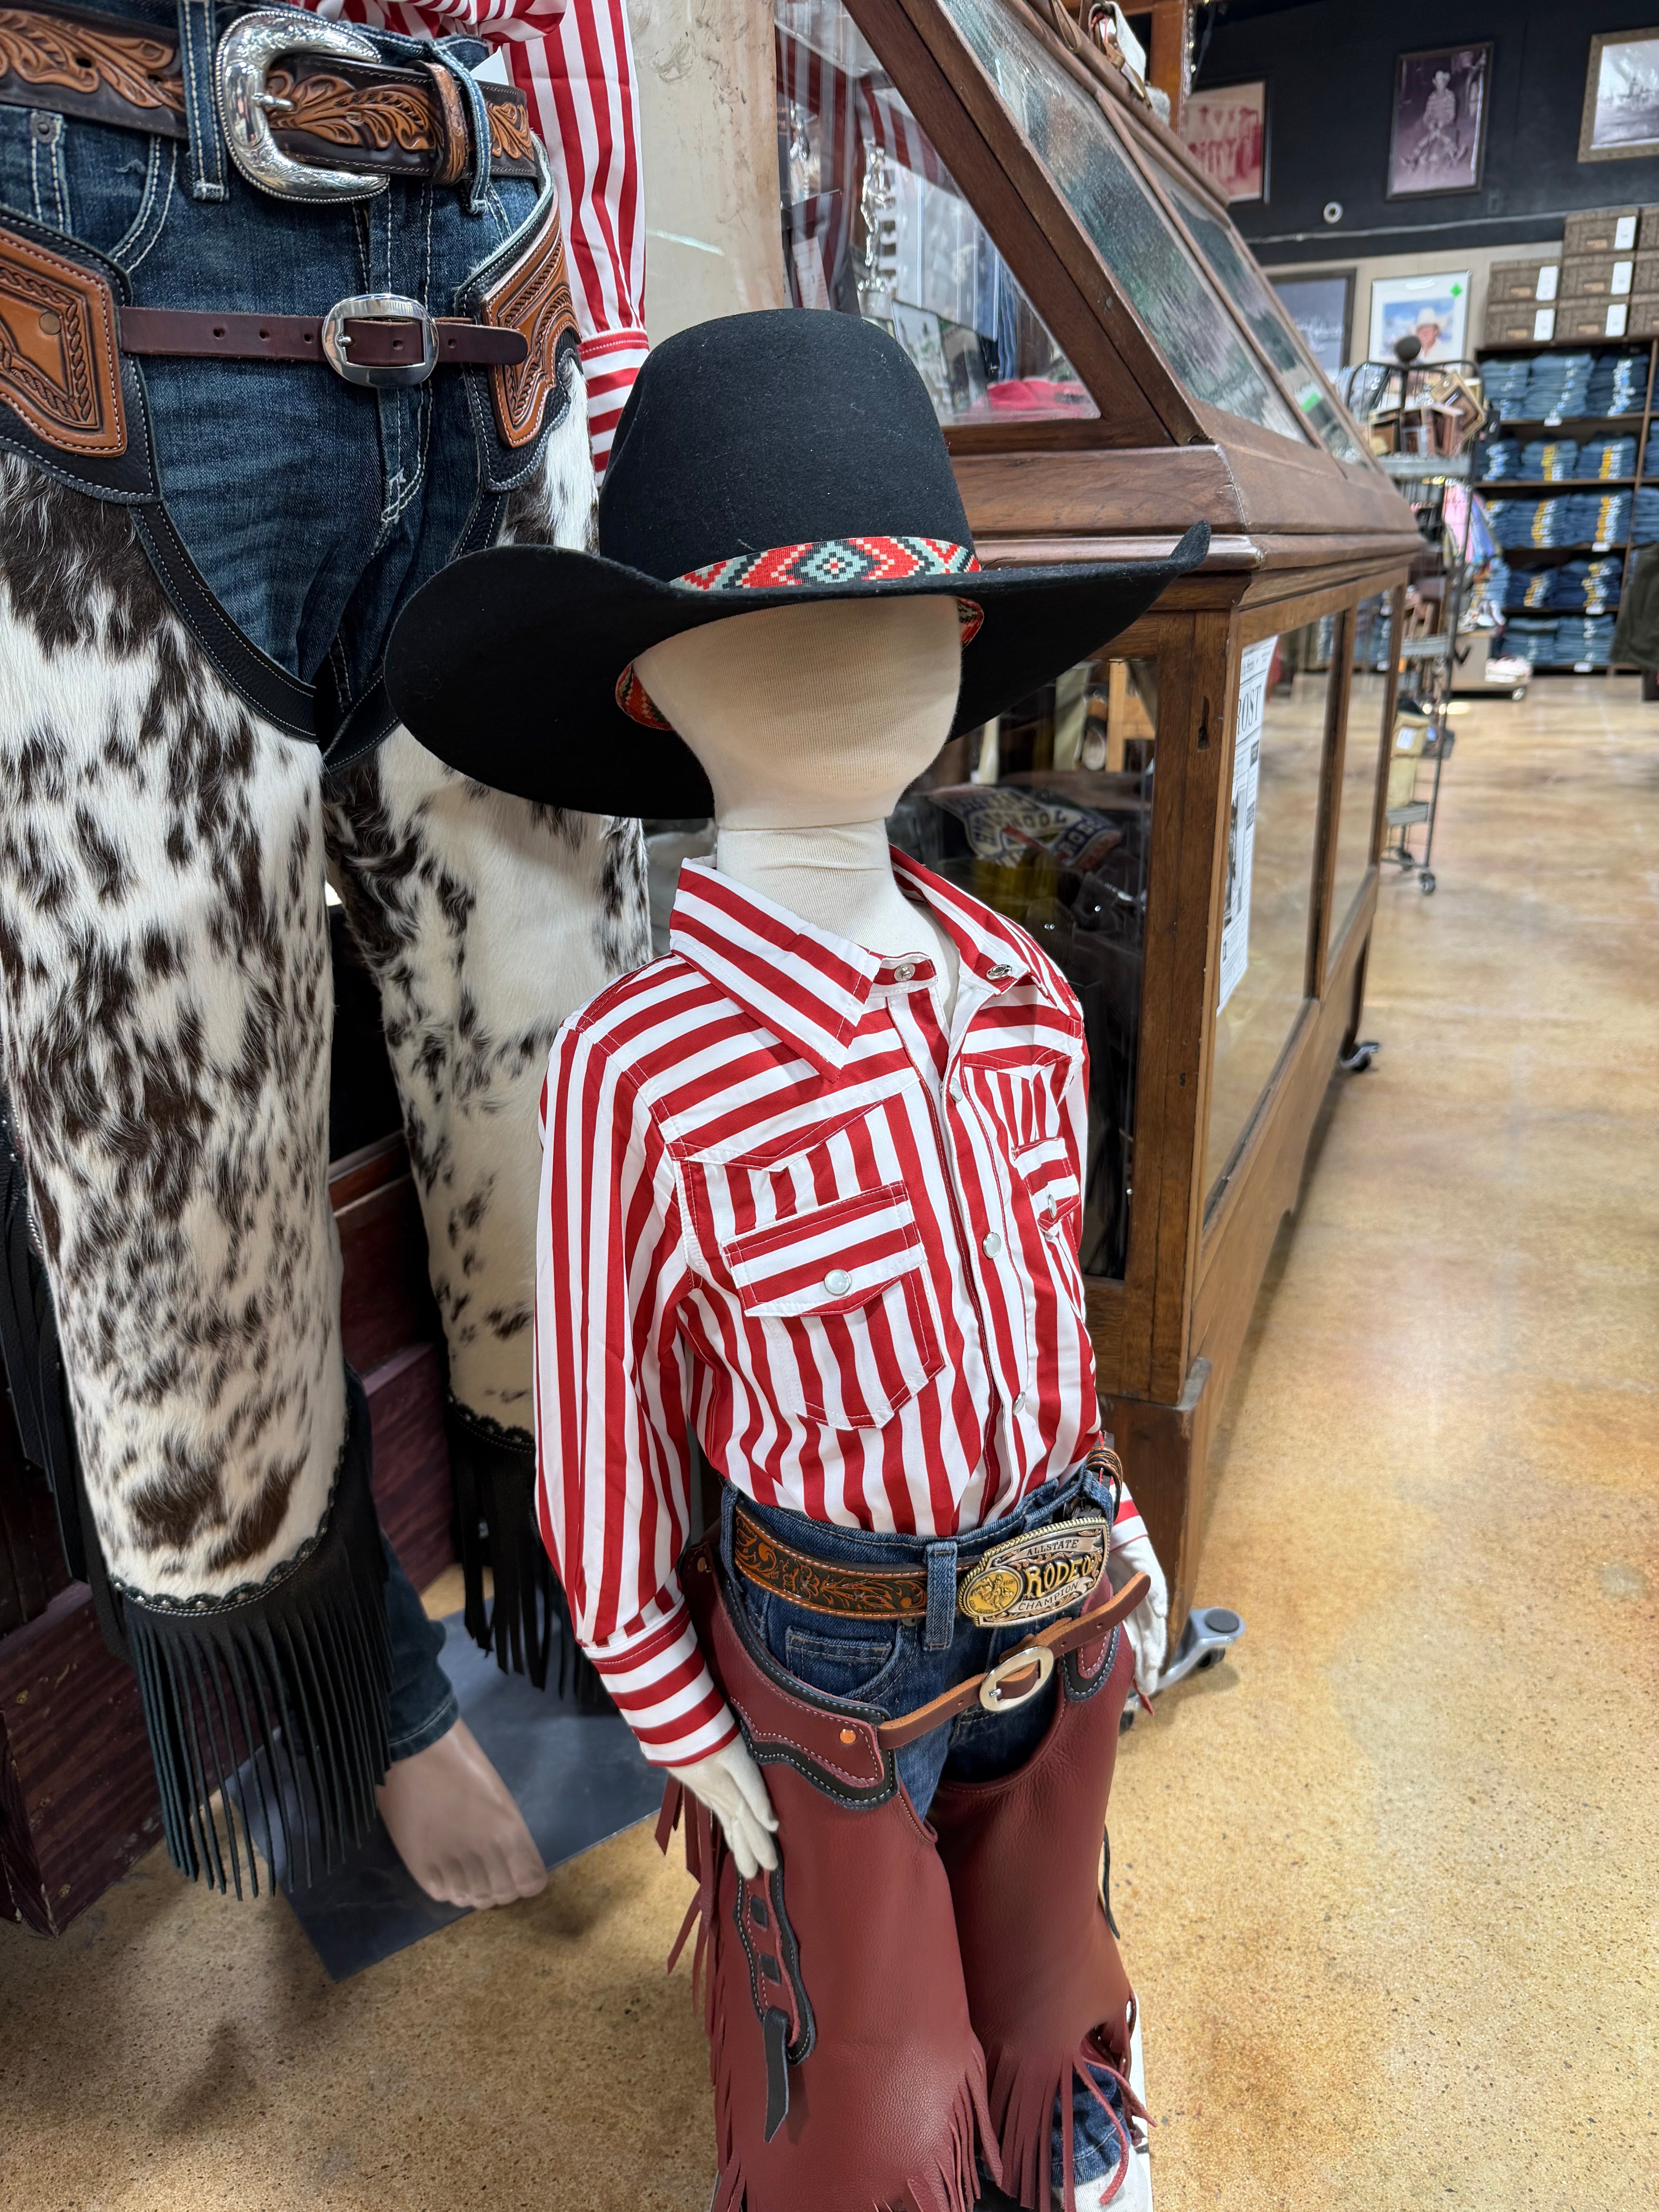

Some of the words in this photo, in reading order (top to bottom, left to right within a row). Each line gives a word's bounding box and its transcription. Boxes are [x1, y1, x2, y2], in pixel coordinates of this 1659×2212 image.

[1027, 1539, 1079, 1556] ALLSTATE
[1025, 1556, 1093, 1598] RODEO
[1018, 1581, 1079, 1611] CHAMPION
